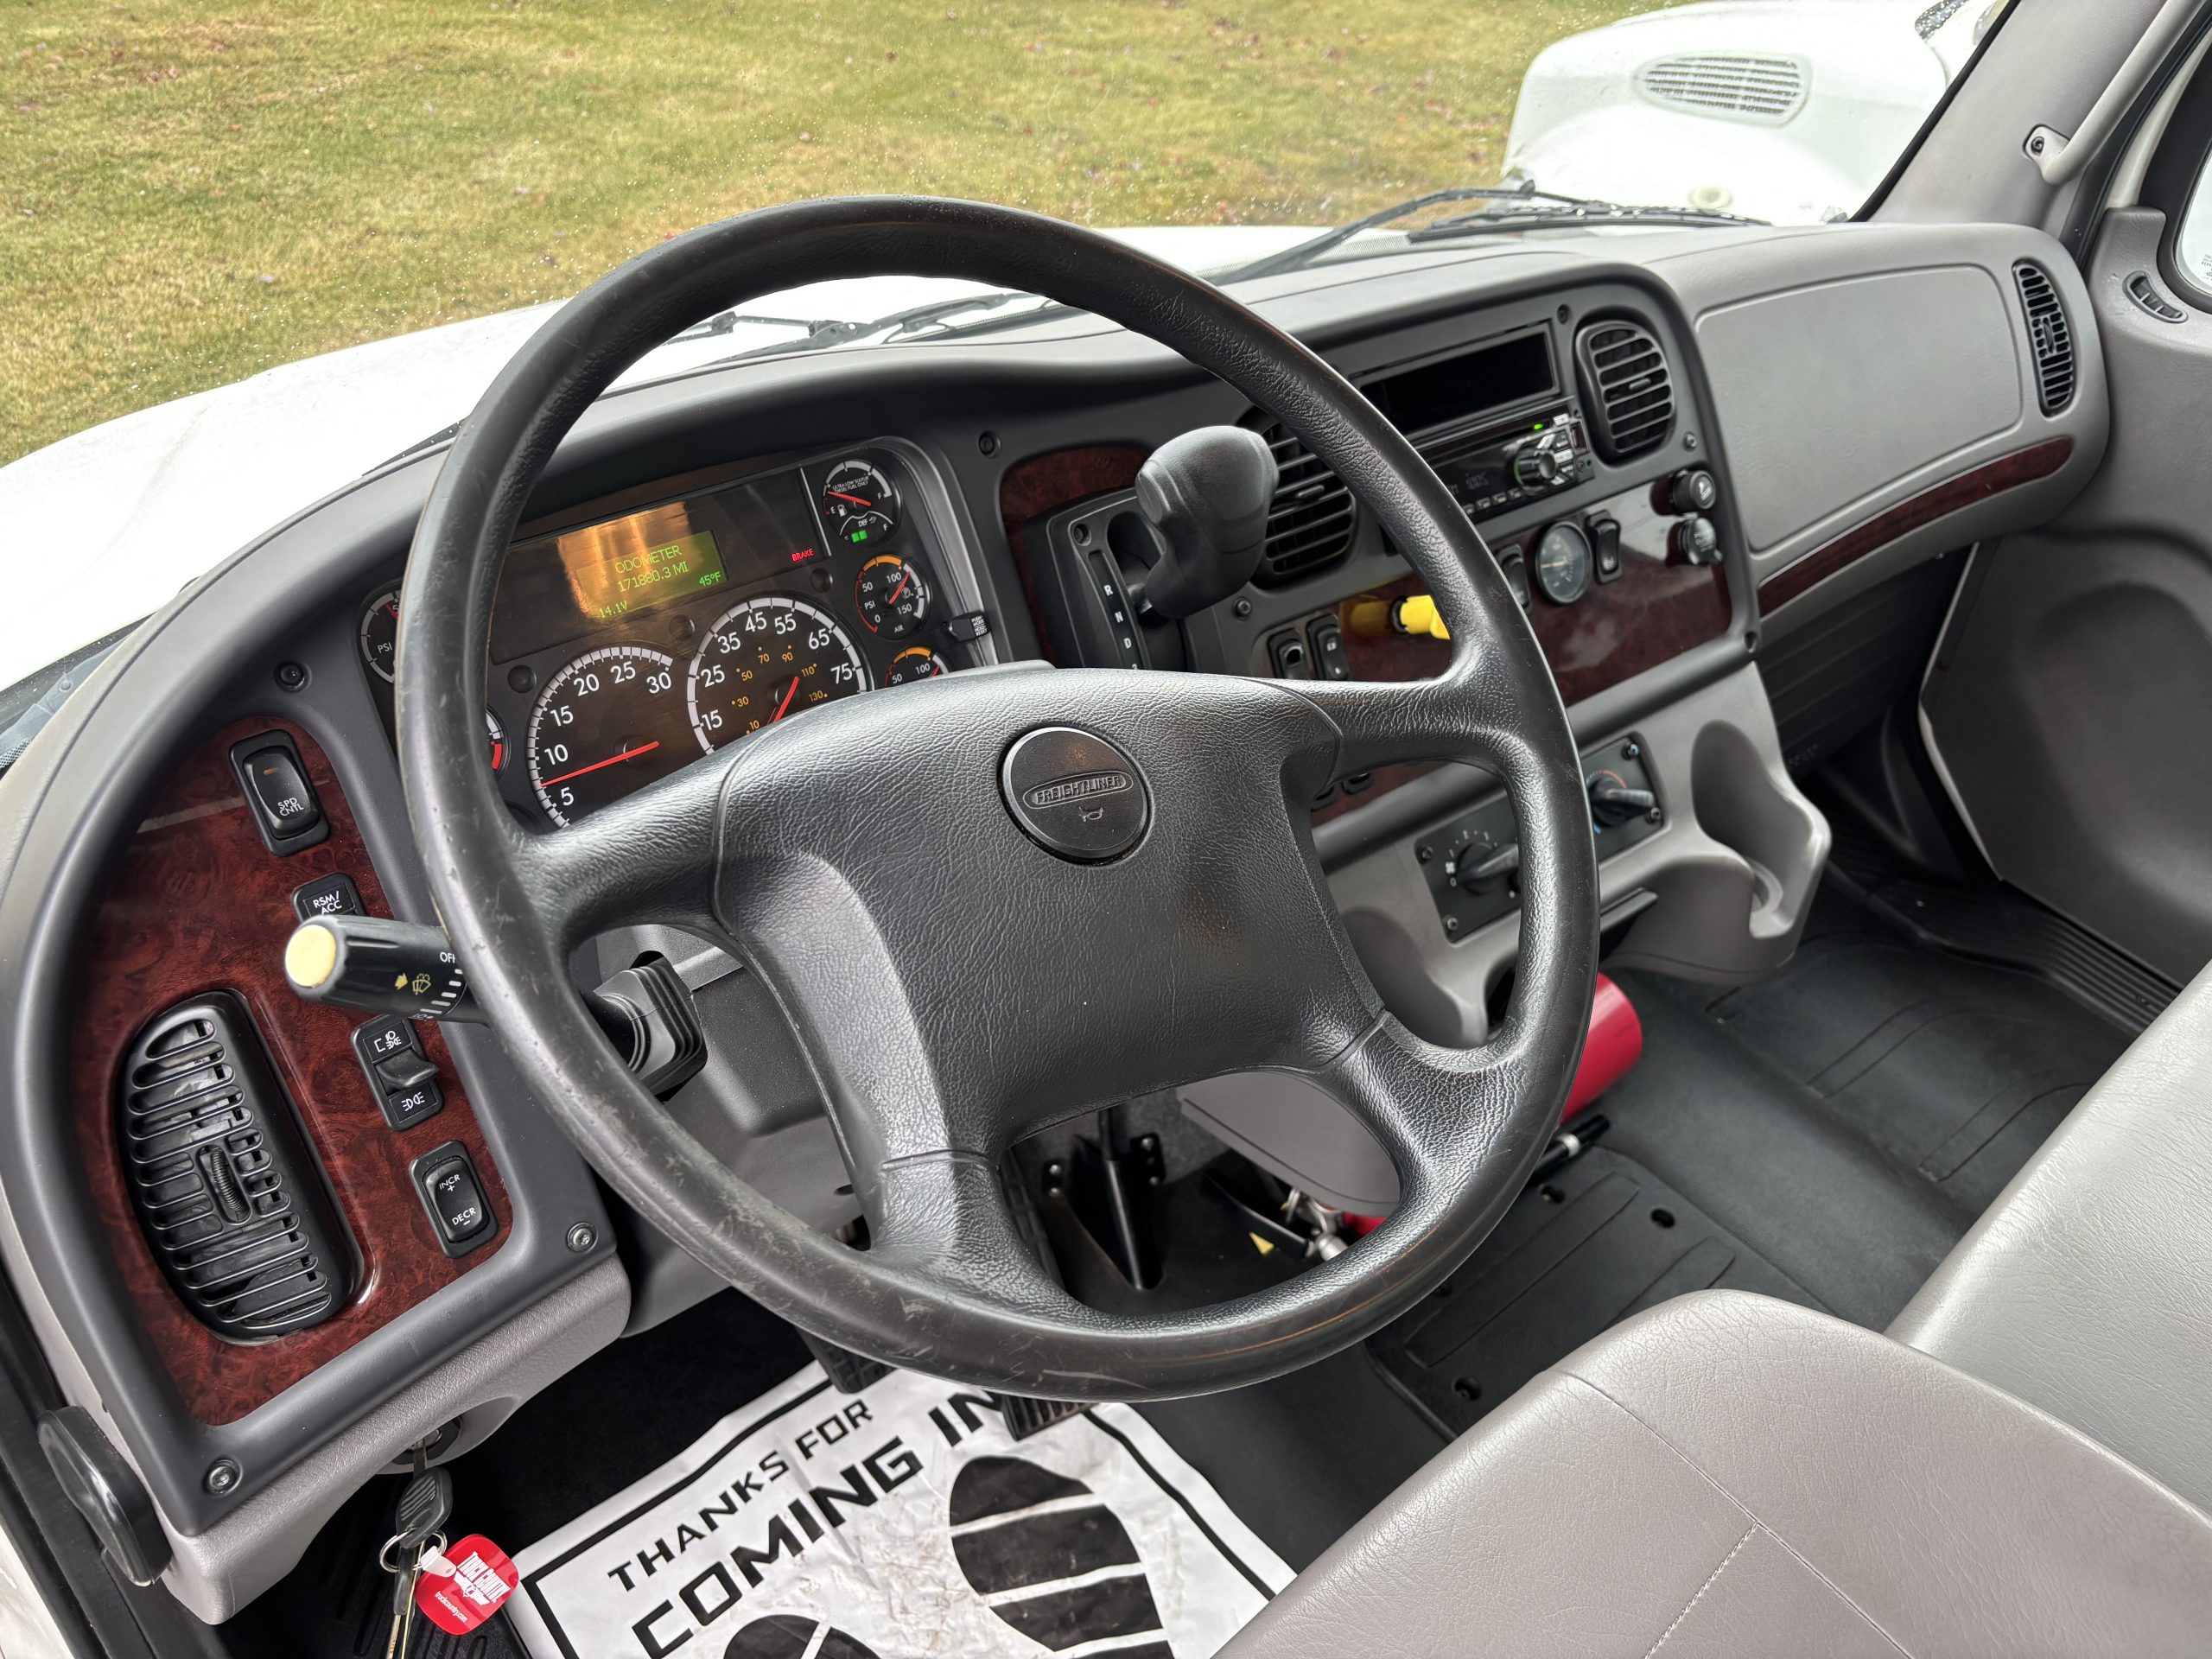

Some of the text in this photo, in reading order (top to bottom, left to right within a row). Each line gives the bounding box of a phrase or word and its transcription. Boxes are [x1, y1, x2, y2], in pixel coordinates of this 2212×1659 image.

[858, 518, 868, 528] DEF
[615, 545, 682, 574] ODOMETER
[791, 548, 814, 562] BRAKE
[617, 561, 690, 592] 171880.3 MI
[699, 571, 722, 588] 45°F
[886, 572, 902, 583] 100
[862, 582, 874, 592] 50
[1103, 584, 1114, 596] R
[598, 601, 629, 619] 14.1V
[864, 601, 876, 611] PSI
[897, 603, 912, 615] 150
[745, 612, 767, 632] 45
[774, 613, 797, 635] 55
[874, 614, 880, 623] 0
[1115, 611, 1124, 623] N
[894, 625, 905, 633] AIR
[717, 632, 741, 654] 35
[808, 628, 830, 650] 65
[1124, 638, 1132, 649] D
[378, 642, 393, 653] PSI
[758, 653, 770, 664] 70
[781, 652, 793, 663] 90
[610, 661, 636, 683] 25
[701, 664, 726, 687] 25
[741, 671, 753, 681] 50
[802, 666, 815, 677] 110
[830, 663, 853, 684] 75
[915, 663, 931, 675] 100
[573, 673, 600, 696] 20
[646, 671, 672, 694] 30
[892, 673, 903, 683] 50
[738, 696, 749, 708] 30
[809, 690, 823, 702] 130
[550, 705, 574, 727] 15
[702, 709, 723, 731] 15
[749, 720, 760, 730] 10
[544, 744, 569, 765] 10
[561, 787, 575, 805] 5
[1036, 776, 1122, 805] FREIGHTLINER
[277, 798, 298, 810] SPD
[279, 804, 304, 817] CNTL
[312, 890, 340, 909] RSM/
[321, 900, 342, 916] ACC
[439, 1173, 461, 1191] INCR
[452, 1207, 476, 1226] DECR
[607, 1399, 874, 1592] THANKS FOR
[632, 1435, 925, 1659] COMING
